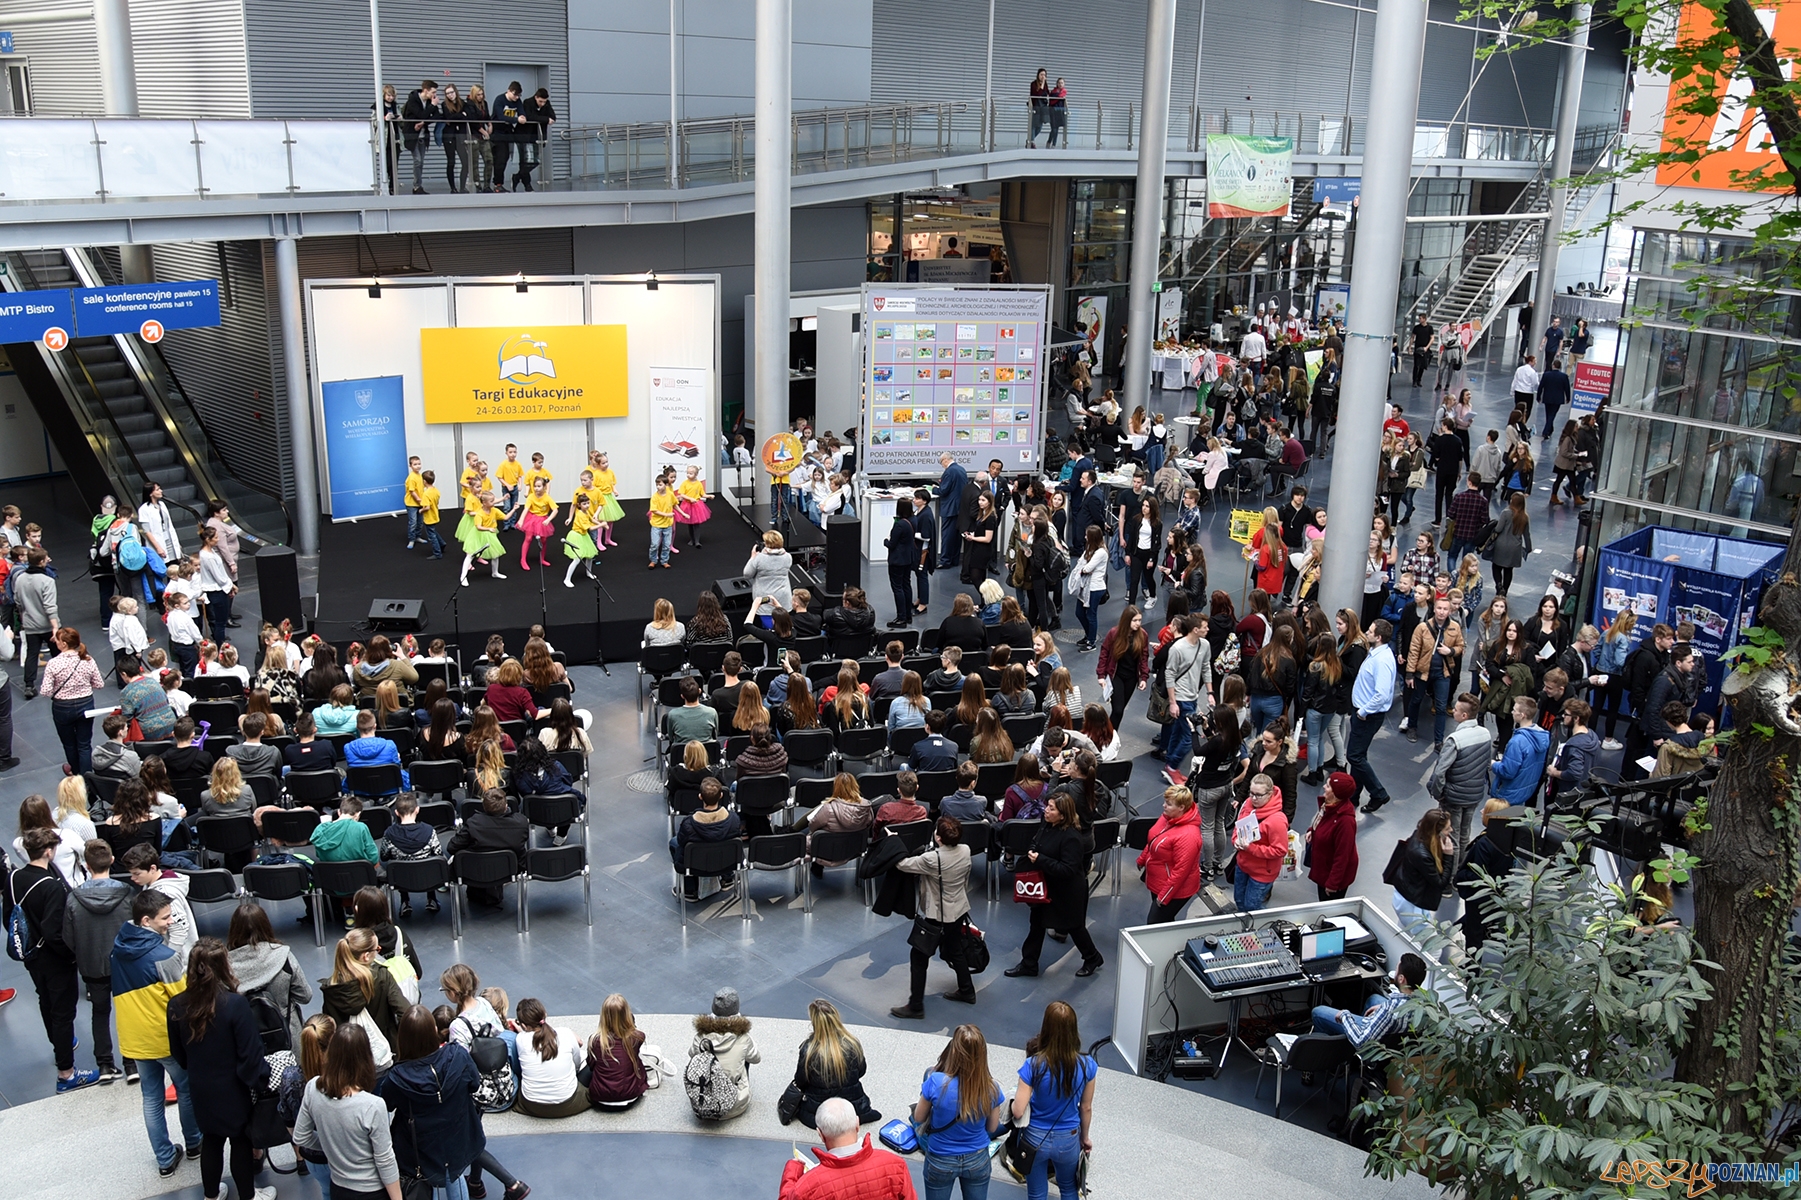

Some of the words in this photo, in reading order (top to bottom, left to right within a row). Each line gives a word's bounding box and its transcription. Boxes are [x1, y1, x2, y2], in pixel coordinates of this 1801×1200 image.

[83, 294, 104, 305] sale
[106, 291, 172, 303] konferencyjne
[174, 289, 201, 300] pawilon
[202, 288, 211, 296] 15
[0, 306, 23, 317] MTP
[26, 304, 55, 315] Bistro
[105, 302, 148, 313] conference
[149, 301, 173, 310] rooms
[472, 388, 505, 403] Targi
[509, 386, 584, 400] Edukacyjne
[476, 404, 546, 416] 24-26.03.2017,
[548, 403, 582, 413] Poznań
[342, 416, 390, 429] SAMORZĄD
[869, 451, 885, 459] POD
[869, 458, 917, 466] AMBASADORA
[1015, 879, 1045, 896] OCA
[888, 1122, 909, 1139] NIKE
